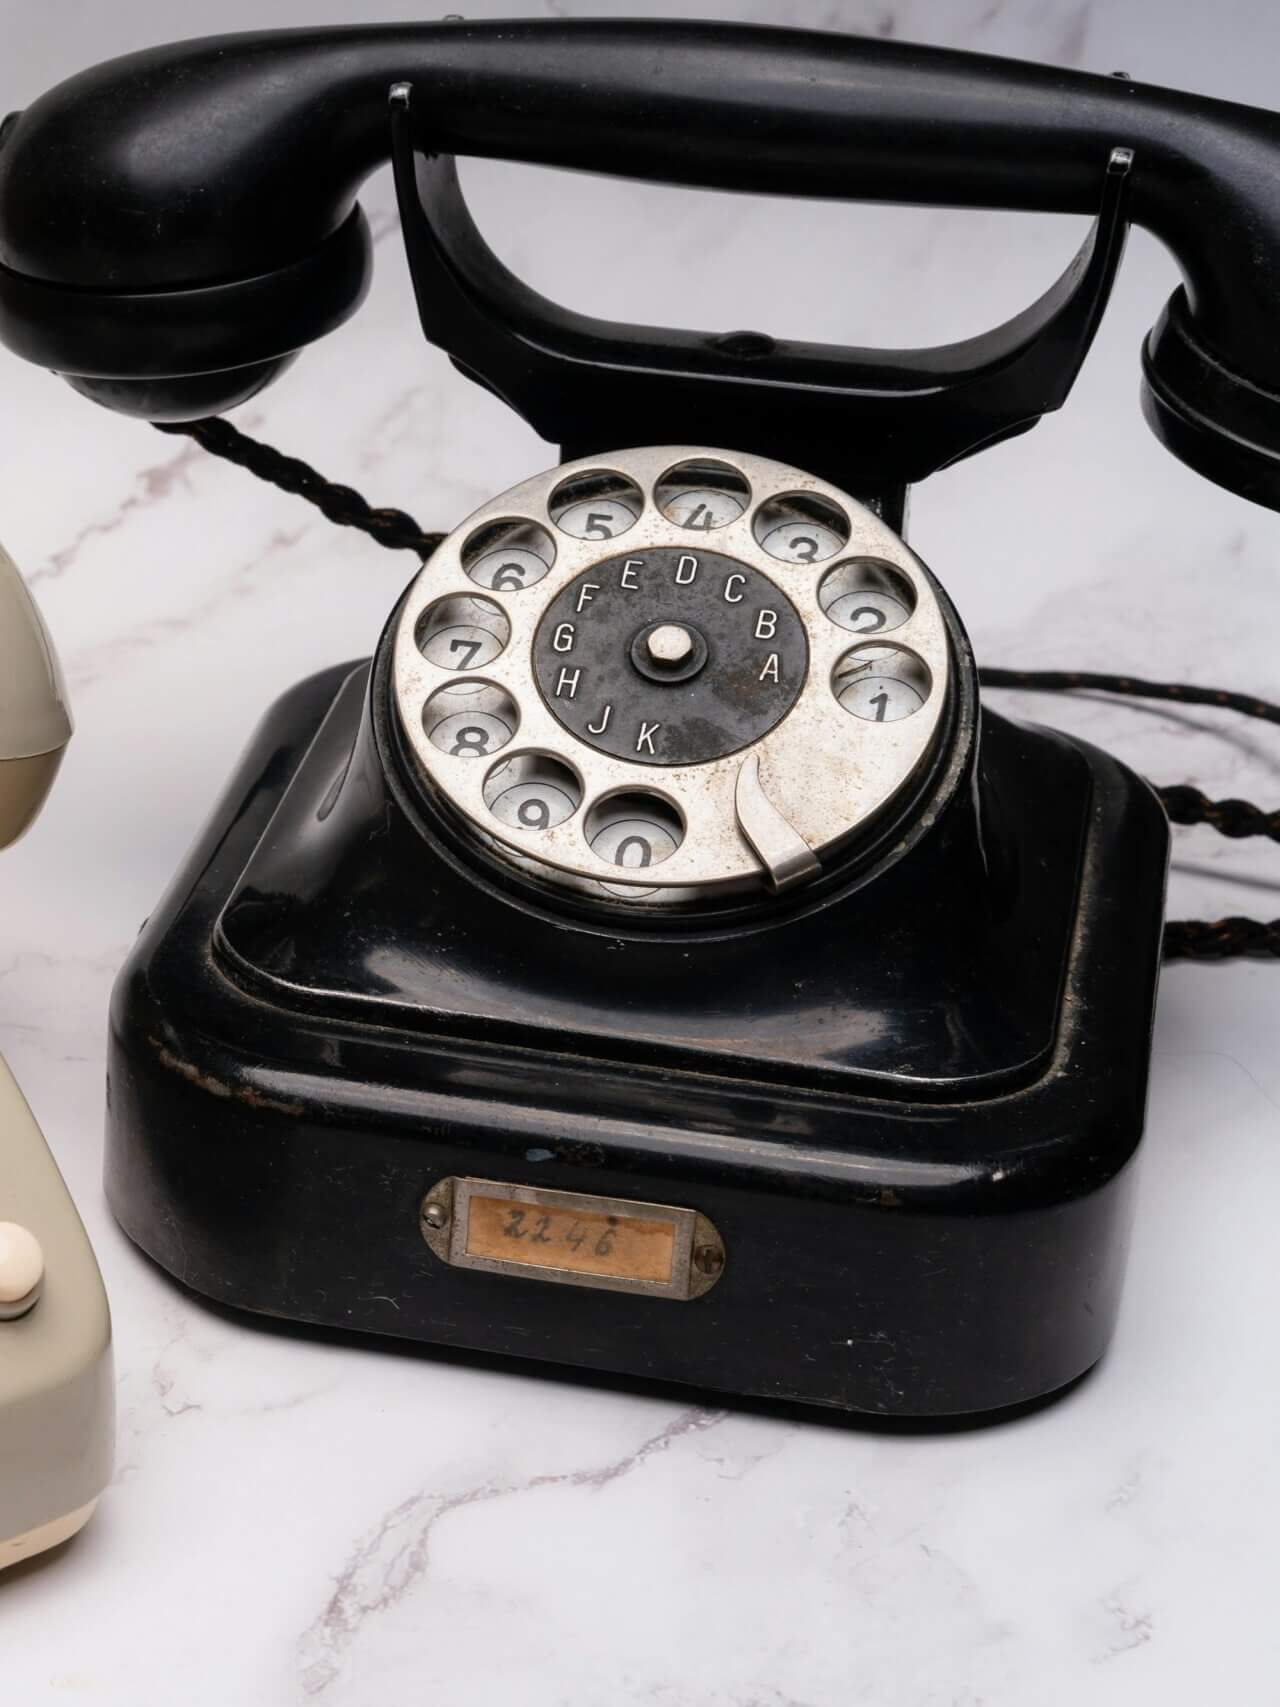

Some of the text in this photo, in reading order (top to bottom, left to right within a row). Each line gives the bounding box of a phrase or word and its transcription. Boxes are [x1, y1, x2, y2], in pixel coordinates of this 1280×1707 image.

[583, 512, 613, 541] 5
[682, 503, 716, 530] 4
[788, 536, 819, 563] 3
[491, 563, 525, 591] 6
[850, 606, 887, 634] 2
[449, 639, 482, 670] 7
[552, 555, 781, 755] A B C D E F G H J K
[869, 692, 888, 722] 1
[451, 726, 489, 757] 8
[519, 798, 550, 830] 9
[503, 1209, 618, 1258] 2246
